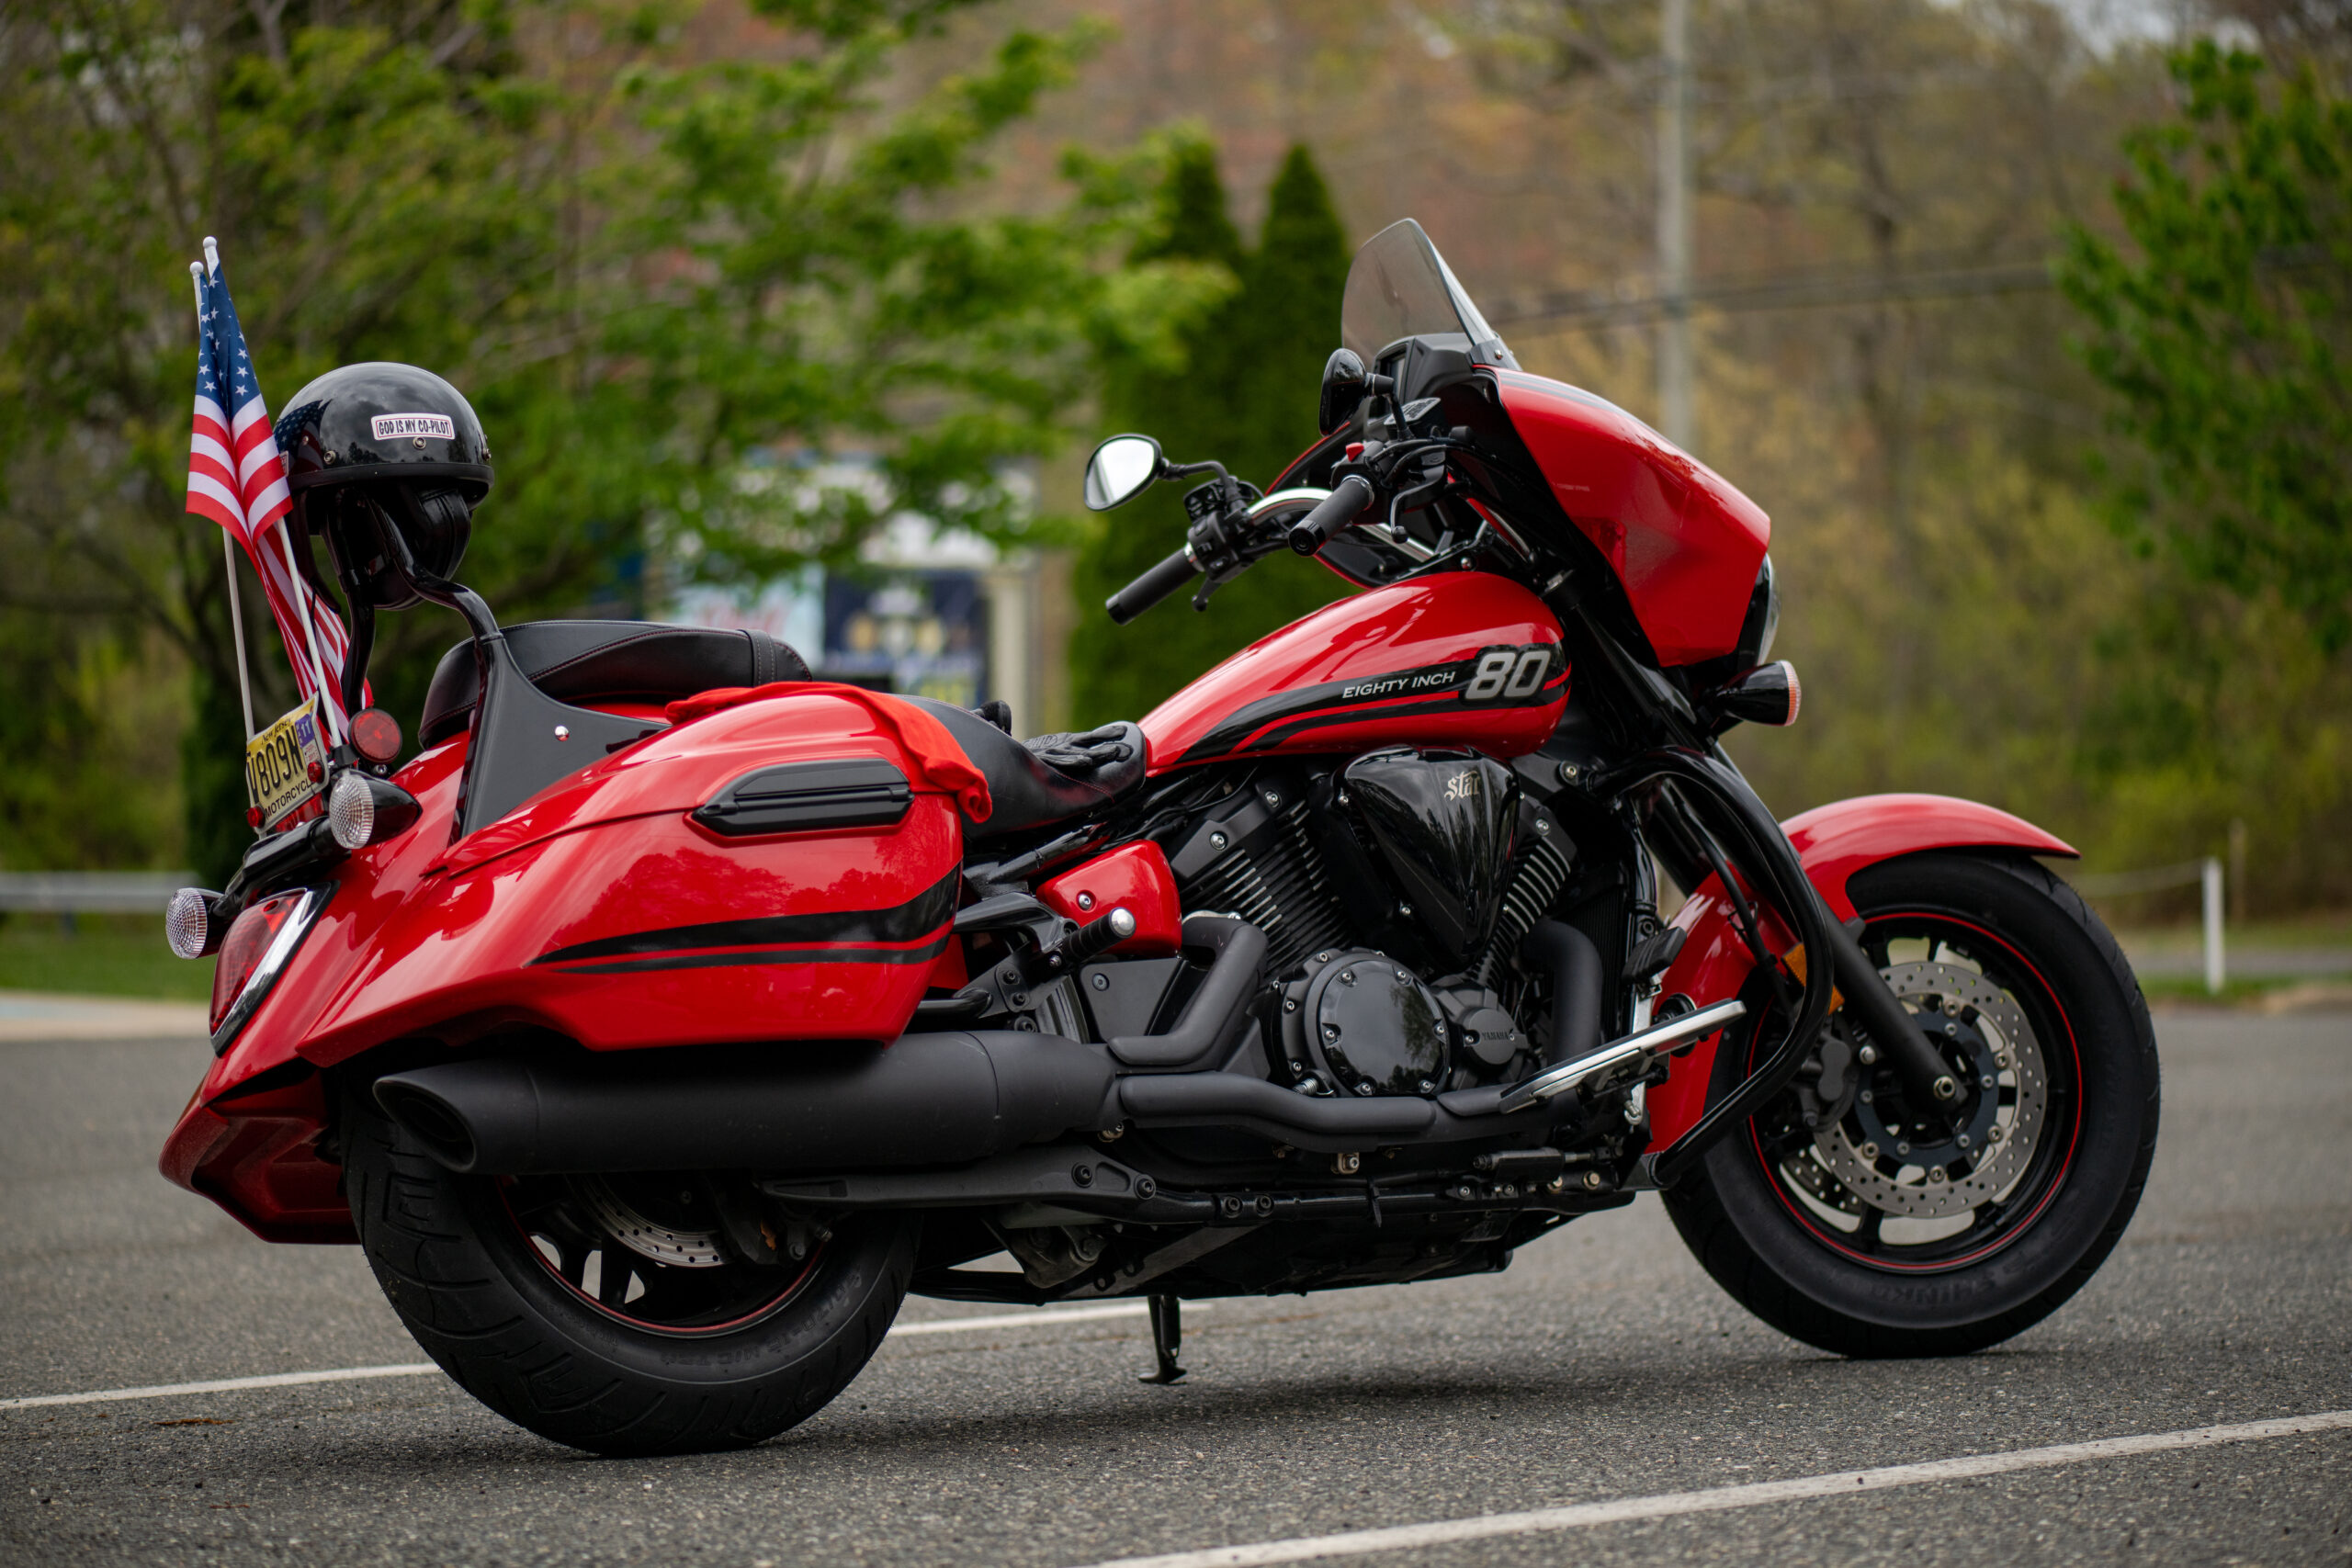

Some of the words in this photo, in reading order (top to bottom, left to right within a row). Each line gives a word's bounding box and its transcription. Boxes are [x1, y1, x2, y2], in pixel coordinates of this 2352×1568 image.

[379, 420, 394, 435] GOD
[396, 420, 404, 434] IS
[405, 419, 416, 434] MY
[418, 419, 450, 435] CO-PILOT
[1342, 678, 1410, 699] EIGHTY
[1411, 671, 1456, 689] INCH
[1464, 649, 1551, 701] 80
[265, 777, 315, 820] MOTORCYCL
[1482, 1030, 1510, 1041] YAMAHA
